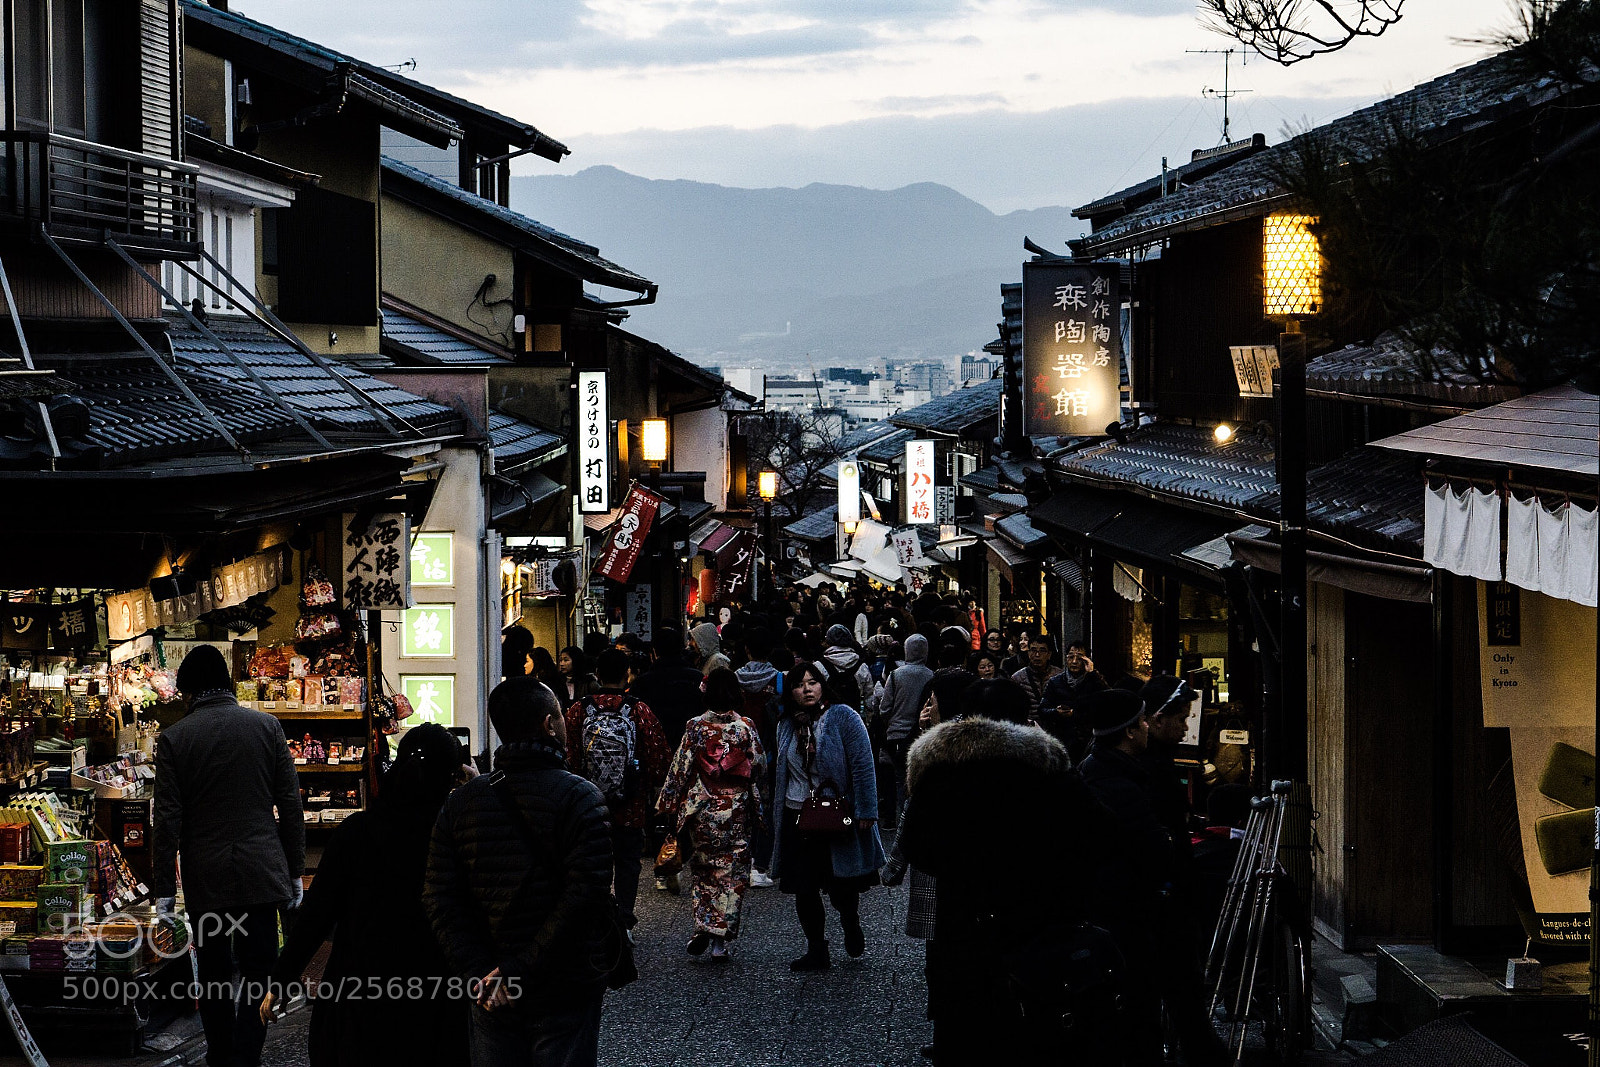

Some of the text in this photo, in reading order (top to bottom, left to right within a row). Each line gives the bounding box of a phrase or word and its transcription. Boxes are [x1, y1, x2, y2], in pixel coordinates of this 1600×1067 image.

[1091, 275, 1111, 367] 創作陶房
[1051, 283, 1090, 417] 森陶器館
[585, 380, 604, 505] 京つけもの 打田
[373, 518, 403, 607] 西陣織
[634, 588, 649, 637] 京扇子
[1493, 653, 1515, 664] Only
[1500, 667, 1509, 675] in
[1492, 678, 1518, 689] Kyoto
[416, 681, 443, 721] 茶
[60, 851, 87, 862] Collon
[45, 895, 73, 907] Collon
[1565, 930, 1582, 940] with
